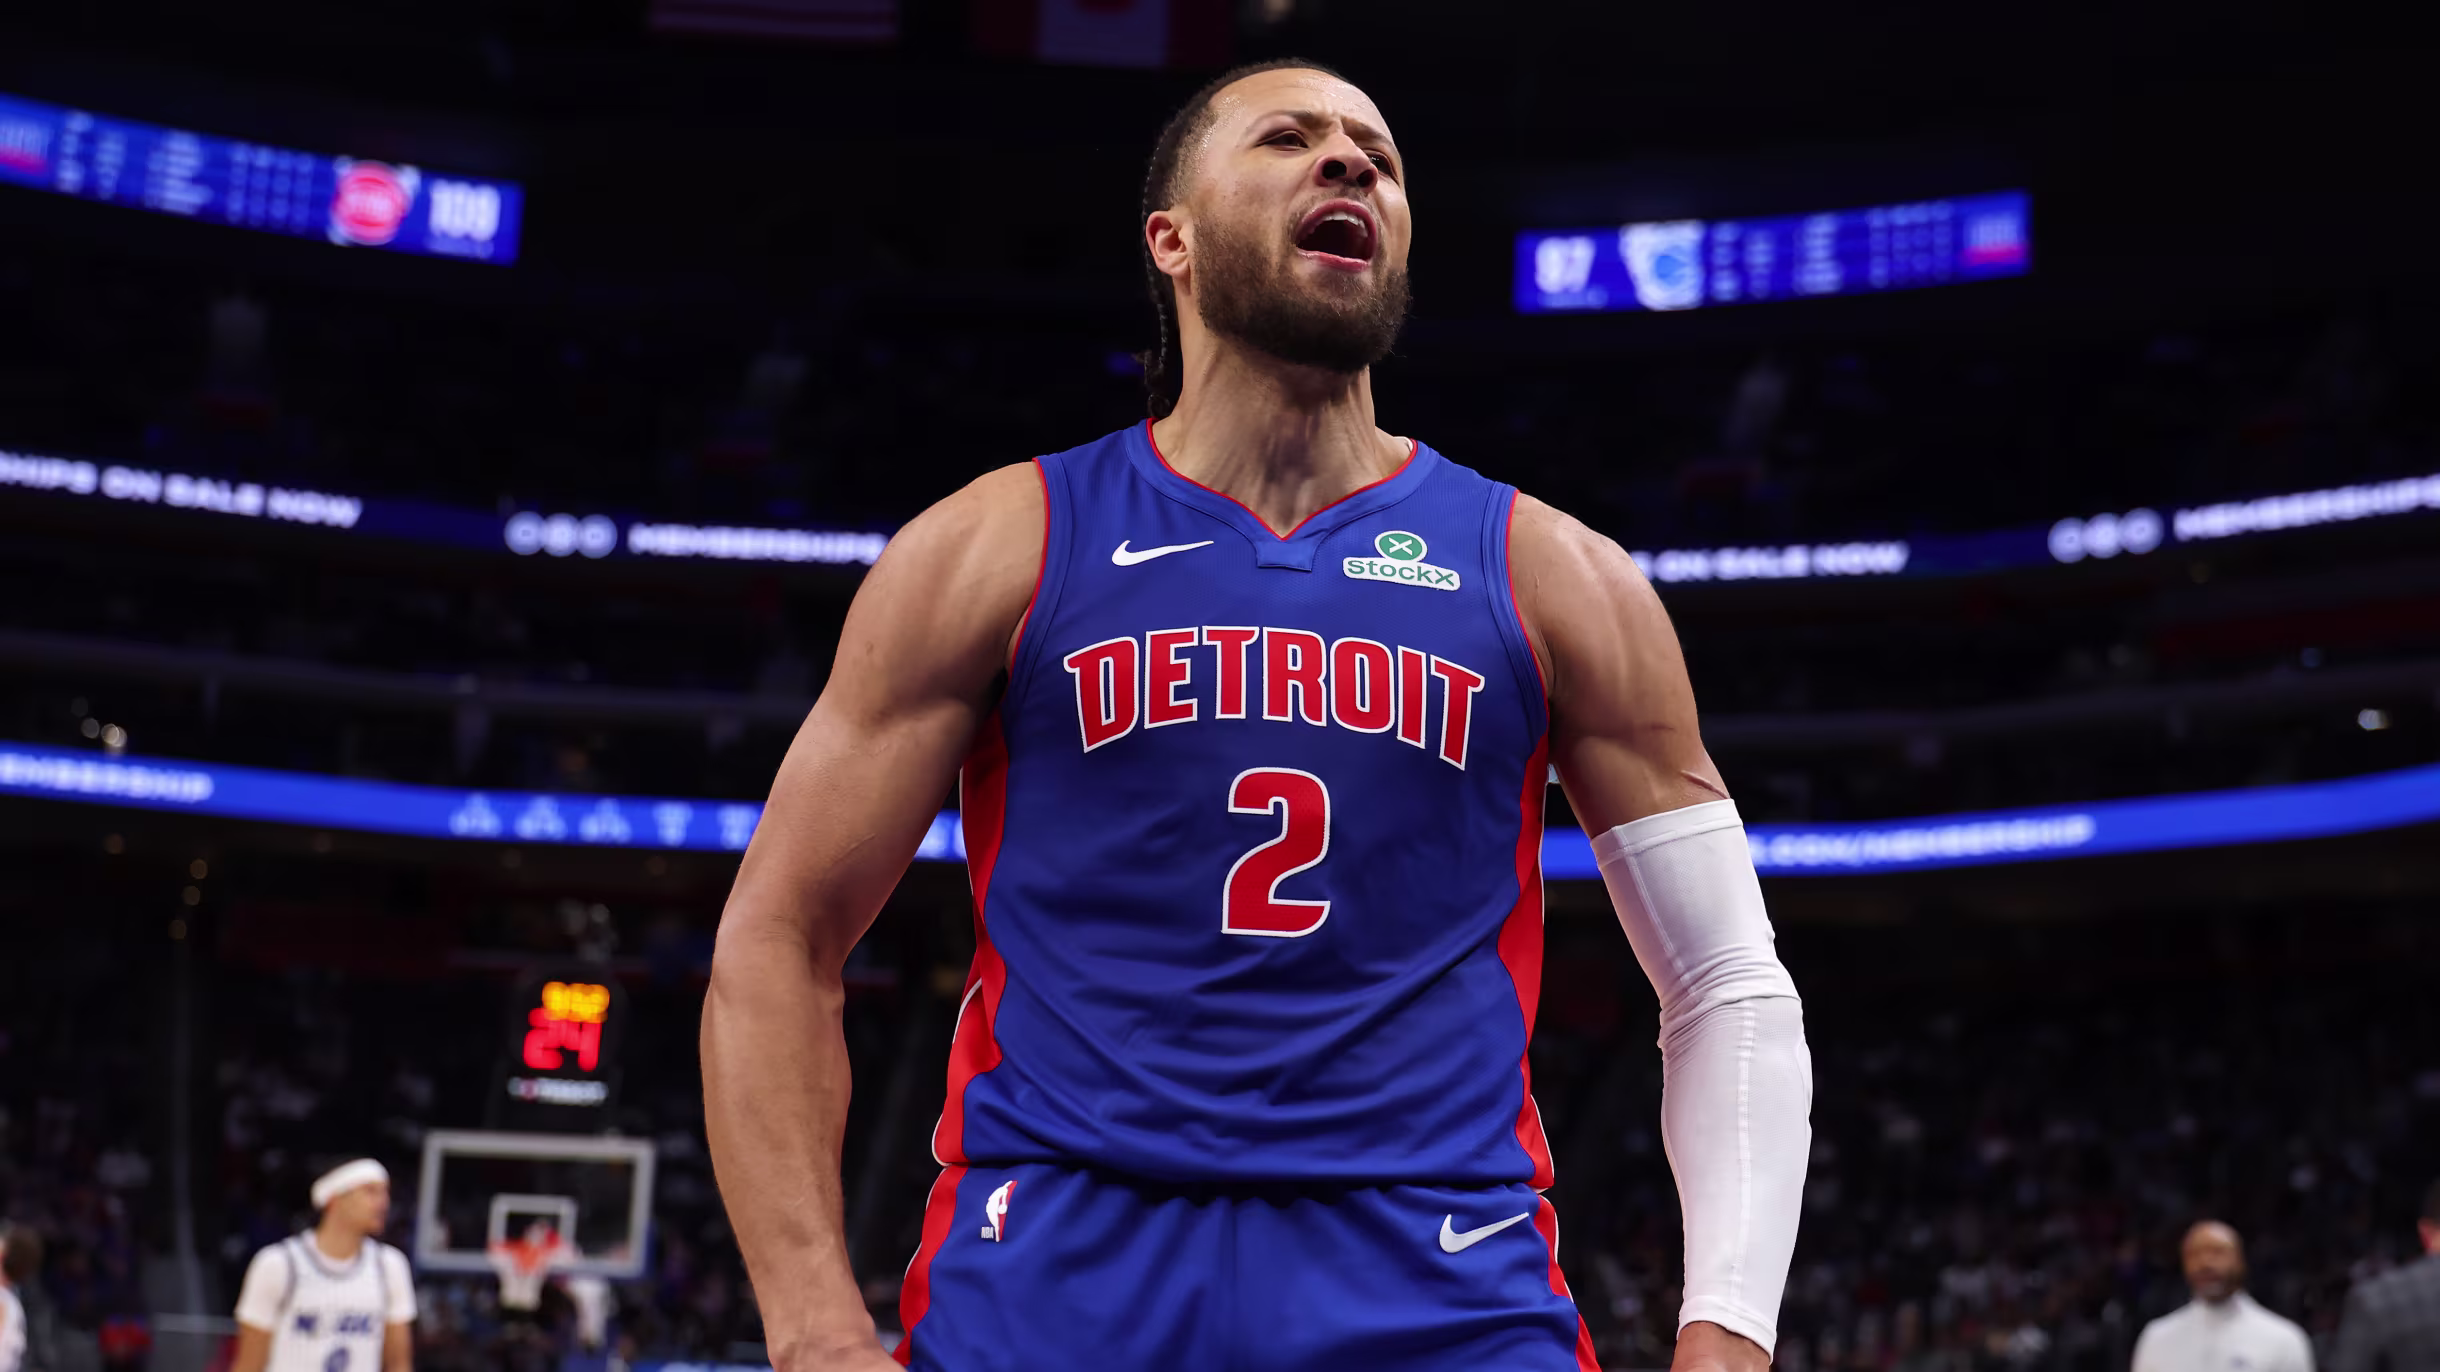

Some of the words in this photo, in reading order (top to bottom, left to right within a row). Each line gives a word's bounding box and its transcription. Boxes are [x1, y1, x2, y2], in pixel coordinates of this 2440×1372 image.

[101, 466, 162, 503] ON
[164, 473, 265, 517] SALE
[267, 486, 363, 529] NOW
[1654, 549, 1711, 582] ON
[1713, 546, 1810, 580] SALE
[1812, 543, 1909, 577] NOW
[1063, 625, 1485, 771] DETROIT
[1221, 766, 1331, 938] 2
[523, 1007, 603, 1072] 24
[980, 1226, 994, 1239] NBA
